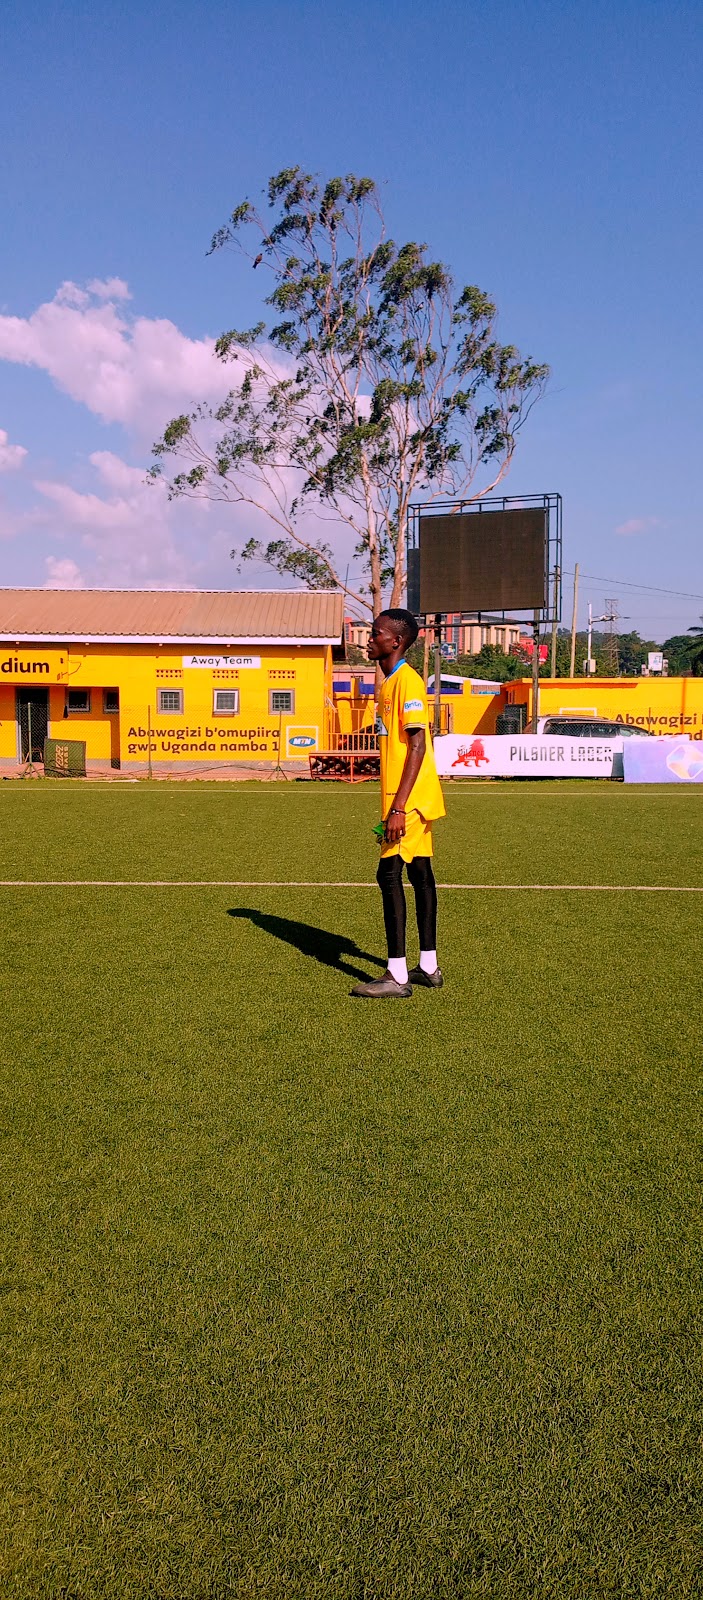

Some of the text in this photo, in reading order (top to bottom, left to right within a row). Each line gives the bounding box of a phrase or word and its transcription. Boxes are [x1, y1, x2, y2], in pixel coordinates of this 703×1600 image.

[1, 657, 50, 673] dium
[190, 656, 253, 666] Away Team
[615, 713, 697, 727] Abawagizi
[128, 727, 280, 740] Abawagizi b'omupiira
[128, 741, 279, 754] gwa Uganda namba 1
[510, 746, 612, 762] PILSNER LAGER
